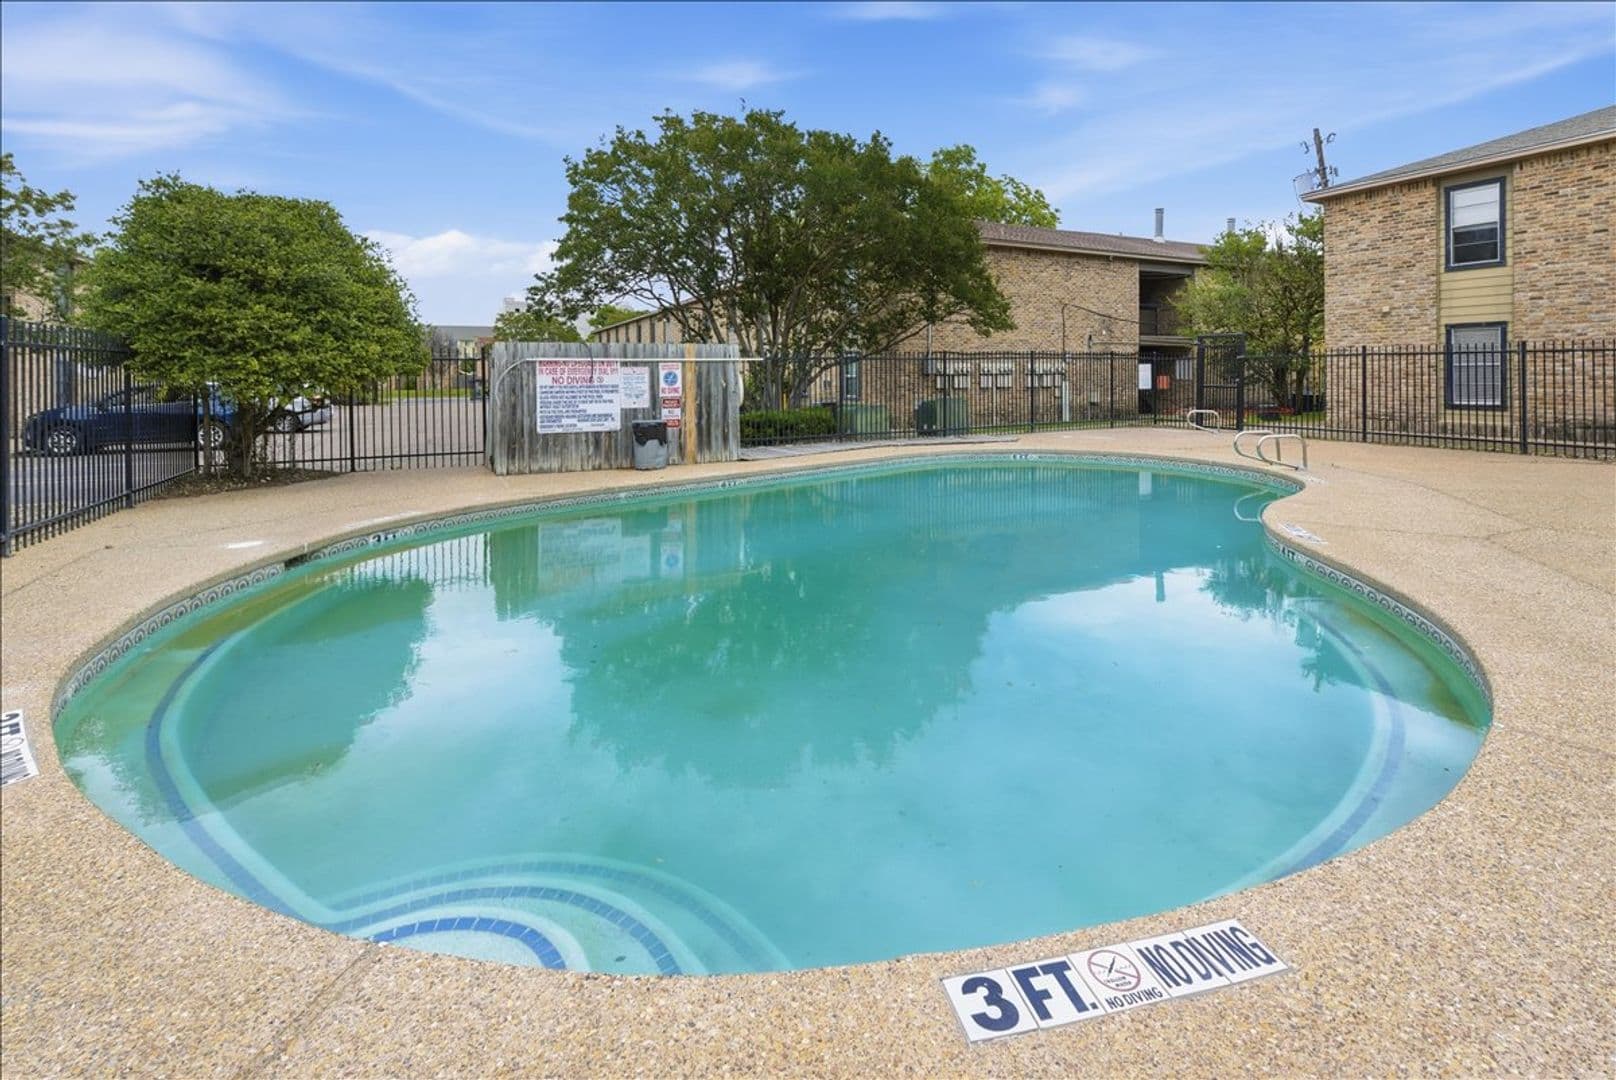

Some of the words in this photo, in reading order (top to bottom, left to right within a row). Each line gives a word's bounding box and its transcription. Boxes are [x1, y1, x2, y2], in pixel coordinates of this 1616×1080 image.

[552, 376, 565, 384] NO
[567, 376, 595, 385] DIVING
[1135, 943, 1192, 989] NO
[1176, 926, 1277, 982] DIVING
[961, 976, 1019, 1032] 3
[1012, 960, 1098, 1021] FT.
[1104, 996, 1125, 1010] NO
[1122, 987, 1163, 1005] DIVING
